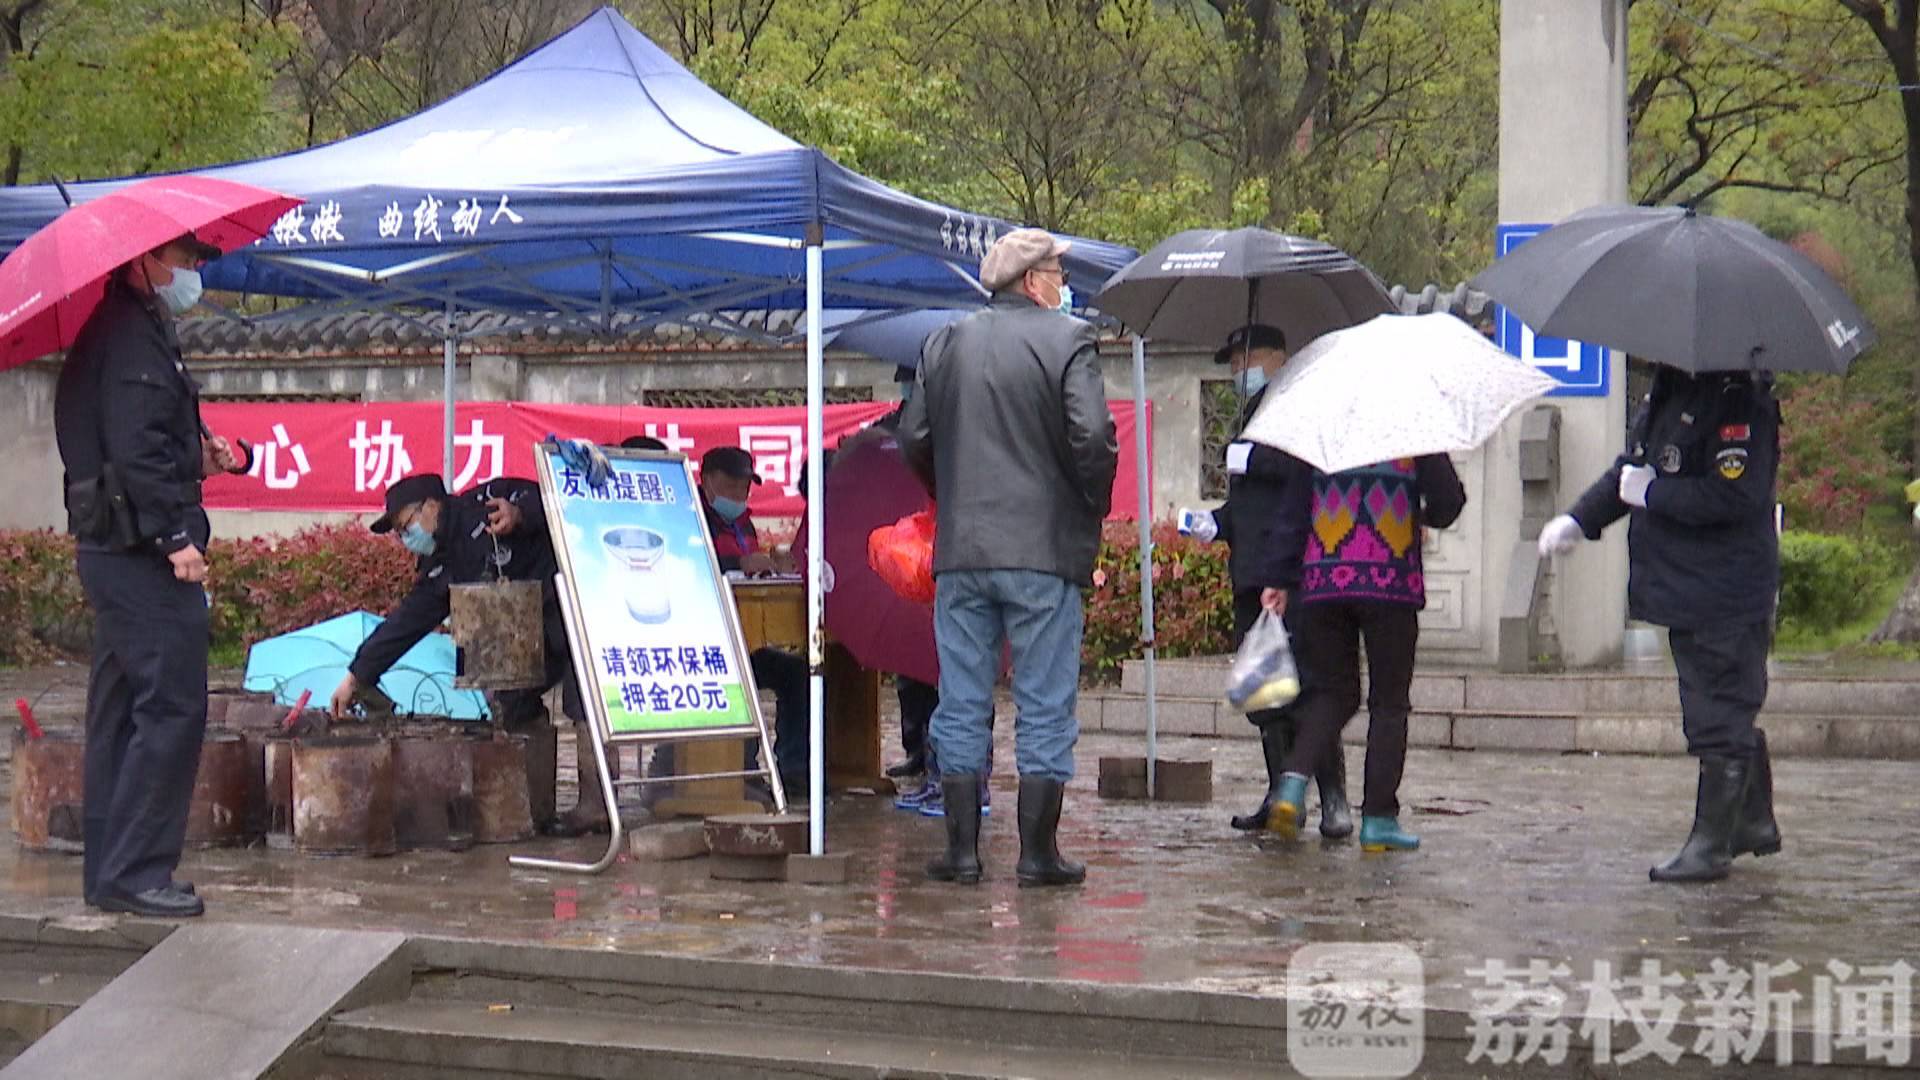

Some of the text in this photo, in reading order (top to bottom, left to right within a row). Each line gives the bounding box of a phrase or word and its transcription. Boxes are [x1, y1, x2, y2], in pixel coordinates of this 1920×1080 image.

[378, 193, 524, 243] 曲线动人
[602, 645, 728, 677] 请领环保桶
[621, 681, 728, 712] 押金20元
